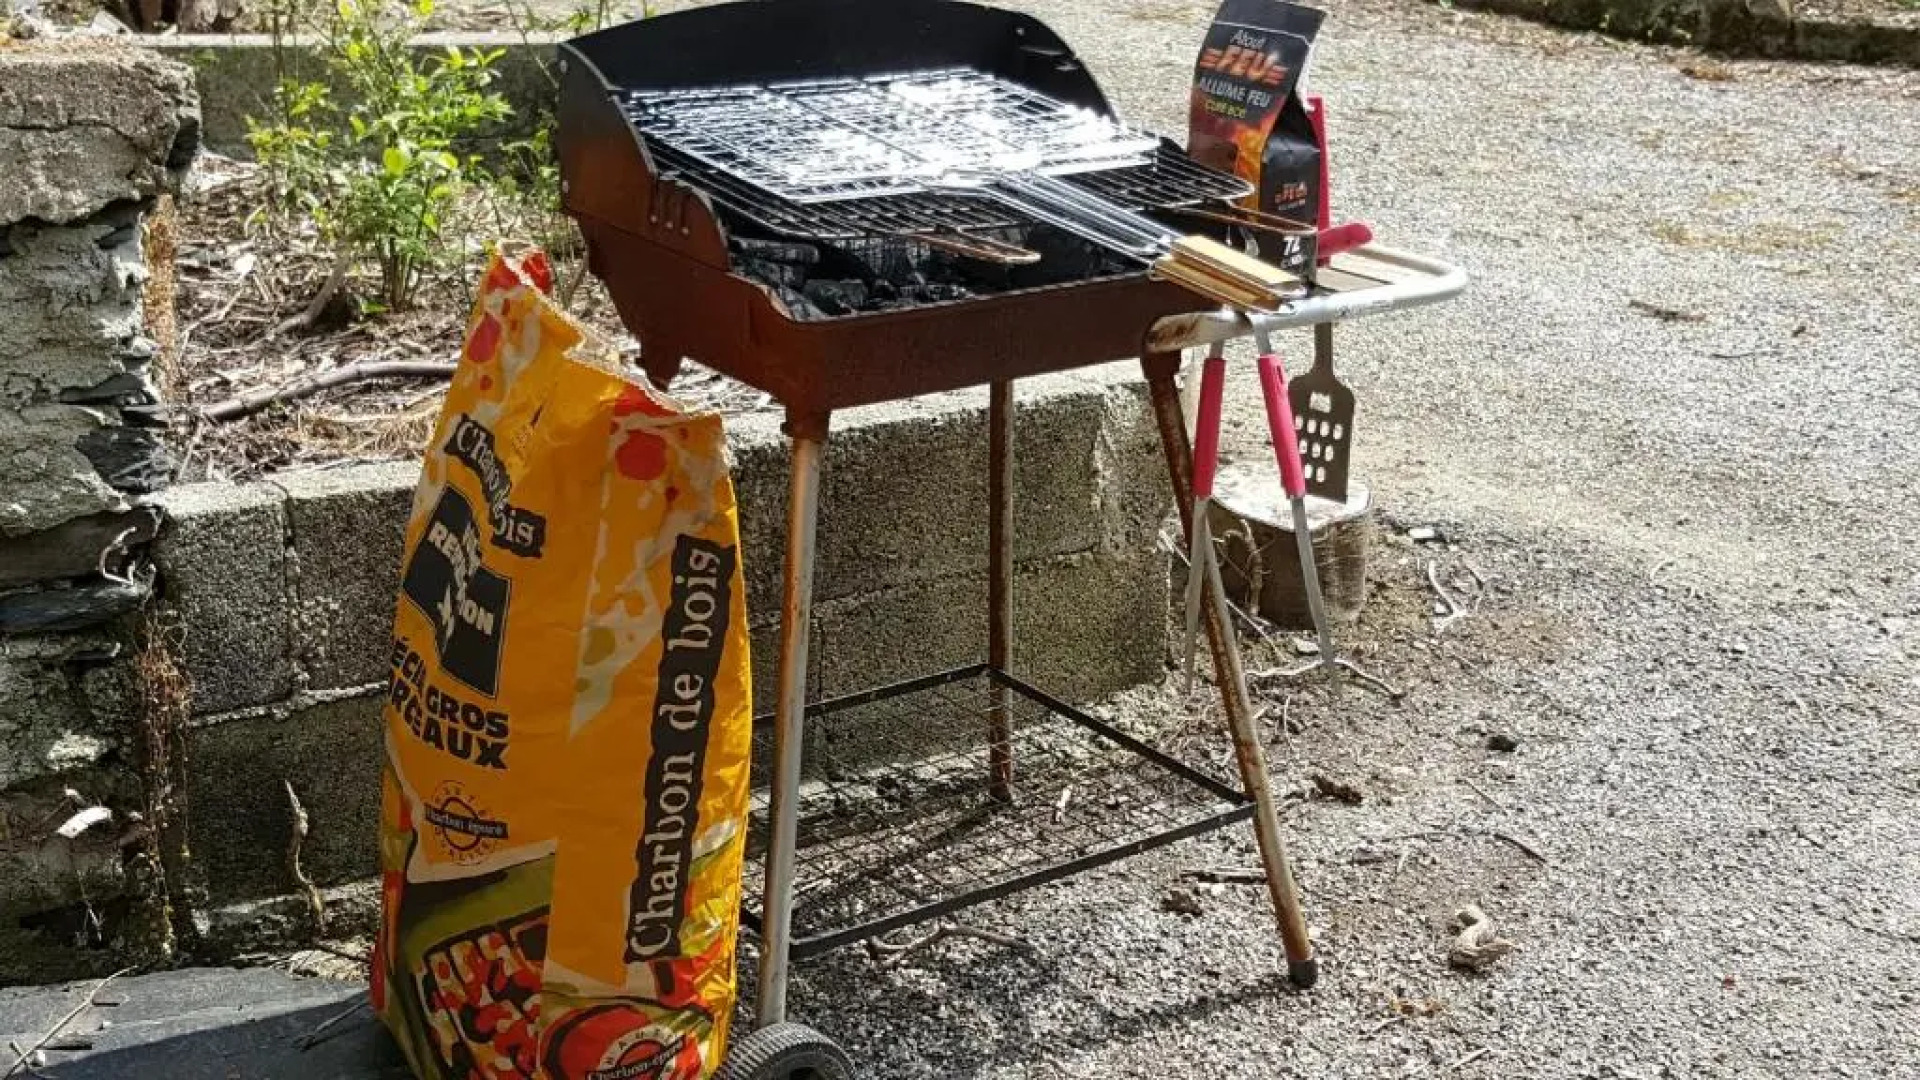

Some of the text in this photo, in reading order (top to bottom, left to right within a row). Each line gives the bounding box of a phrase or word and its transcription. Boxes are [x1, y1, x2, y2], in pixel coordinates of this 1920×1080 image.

[1216, 44, 1281, 80] FEU
[1200, 77, 1271, 108] ALLUME FEU
[426, 683, 509, 740] GROS
[631, 548, 721, 958] Charbon de bois
